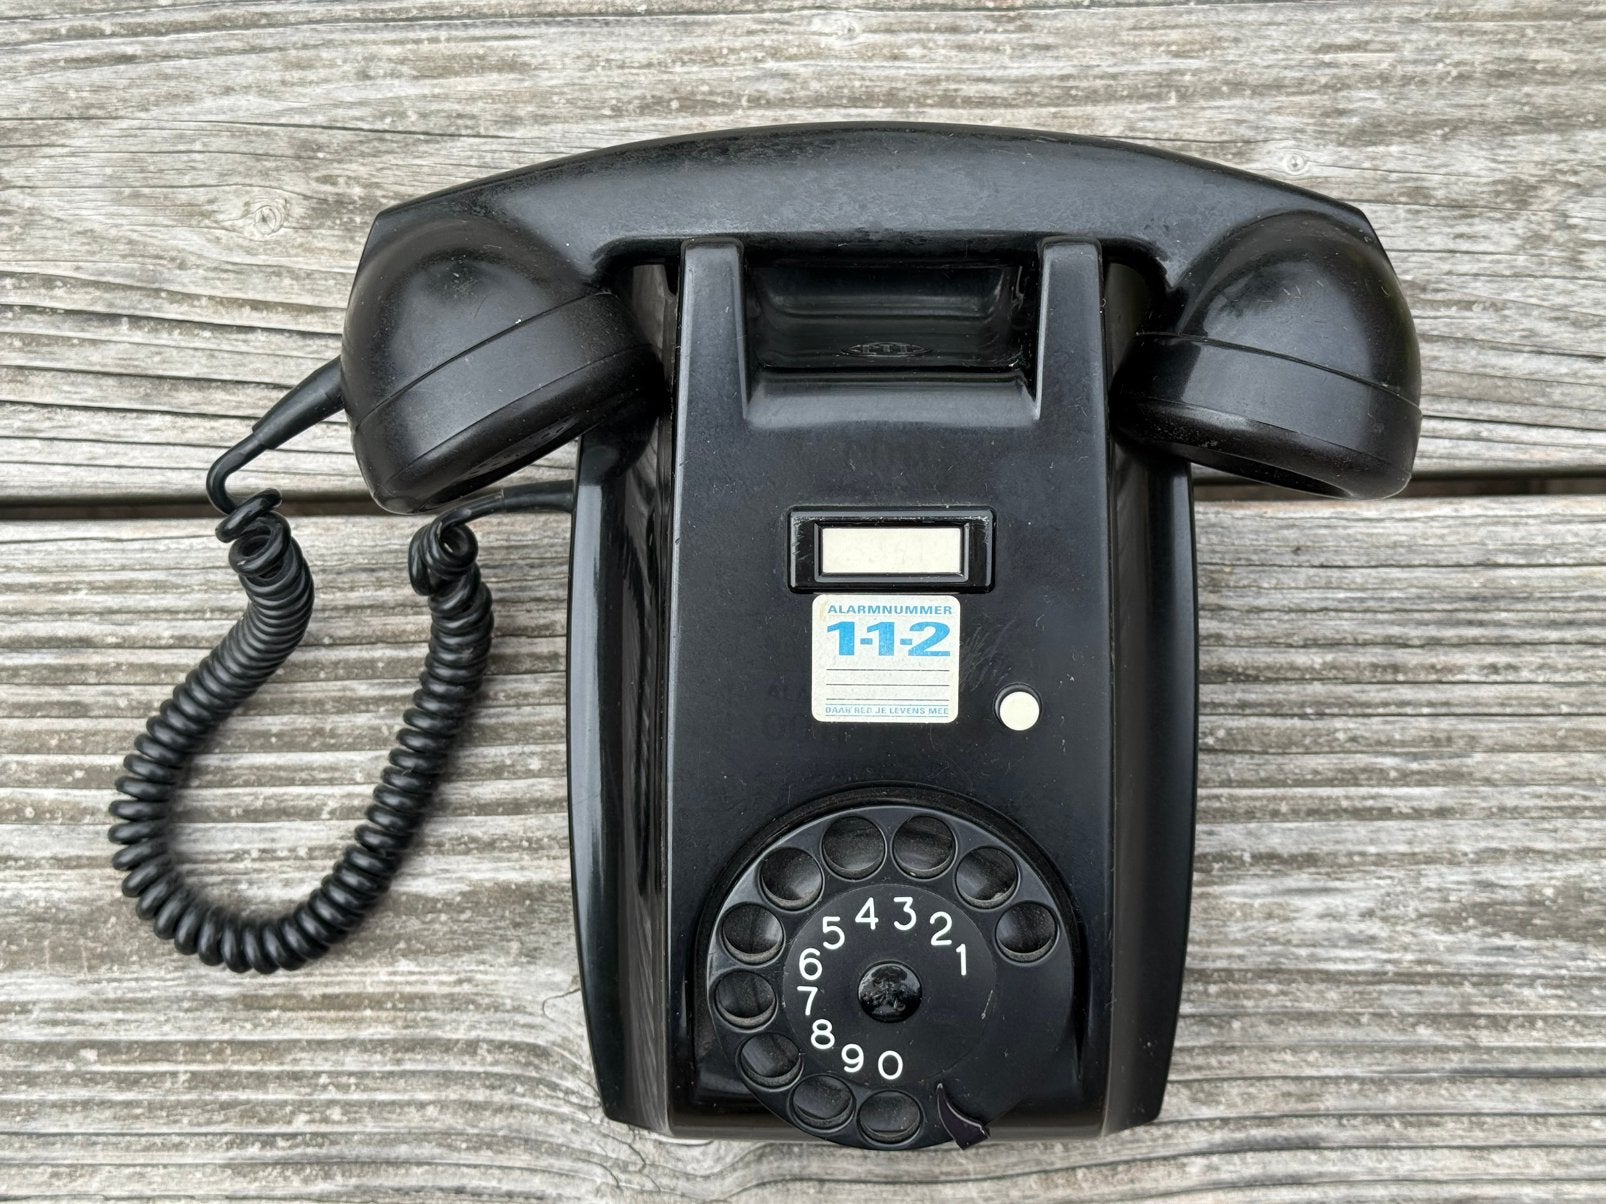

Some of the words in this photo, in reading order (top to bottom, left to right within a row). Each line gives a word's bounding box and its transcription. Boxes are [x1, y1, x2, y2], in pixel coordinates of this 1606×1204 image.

[827, 604, 953, 615] ALARMNUMMER
[826, 621, 951, 657] 1-1-2
[854, 706, 873, 714] RED
[875, 707, 887, 715] JE
[889, 707, 926, 715] LEVENS
[928, 707, 949, 715] MEE
[854, 896, 880, 931] 4
[893, 896, 917, 932] 3
[929, 910, 953, 947] 2
[821, 915, 846, 951] 5
[798, 947, 823, 981] 6
[955, 943, 967, 977] 1
[796, 985, 819, 1017] 7
[810, 1018, 836, 1050] 8
[840, 1043, 865, 1074] 9
